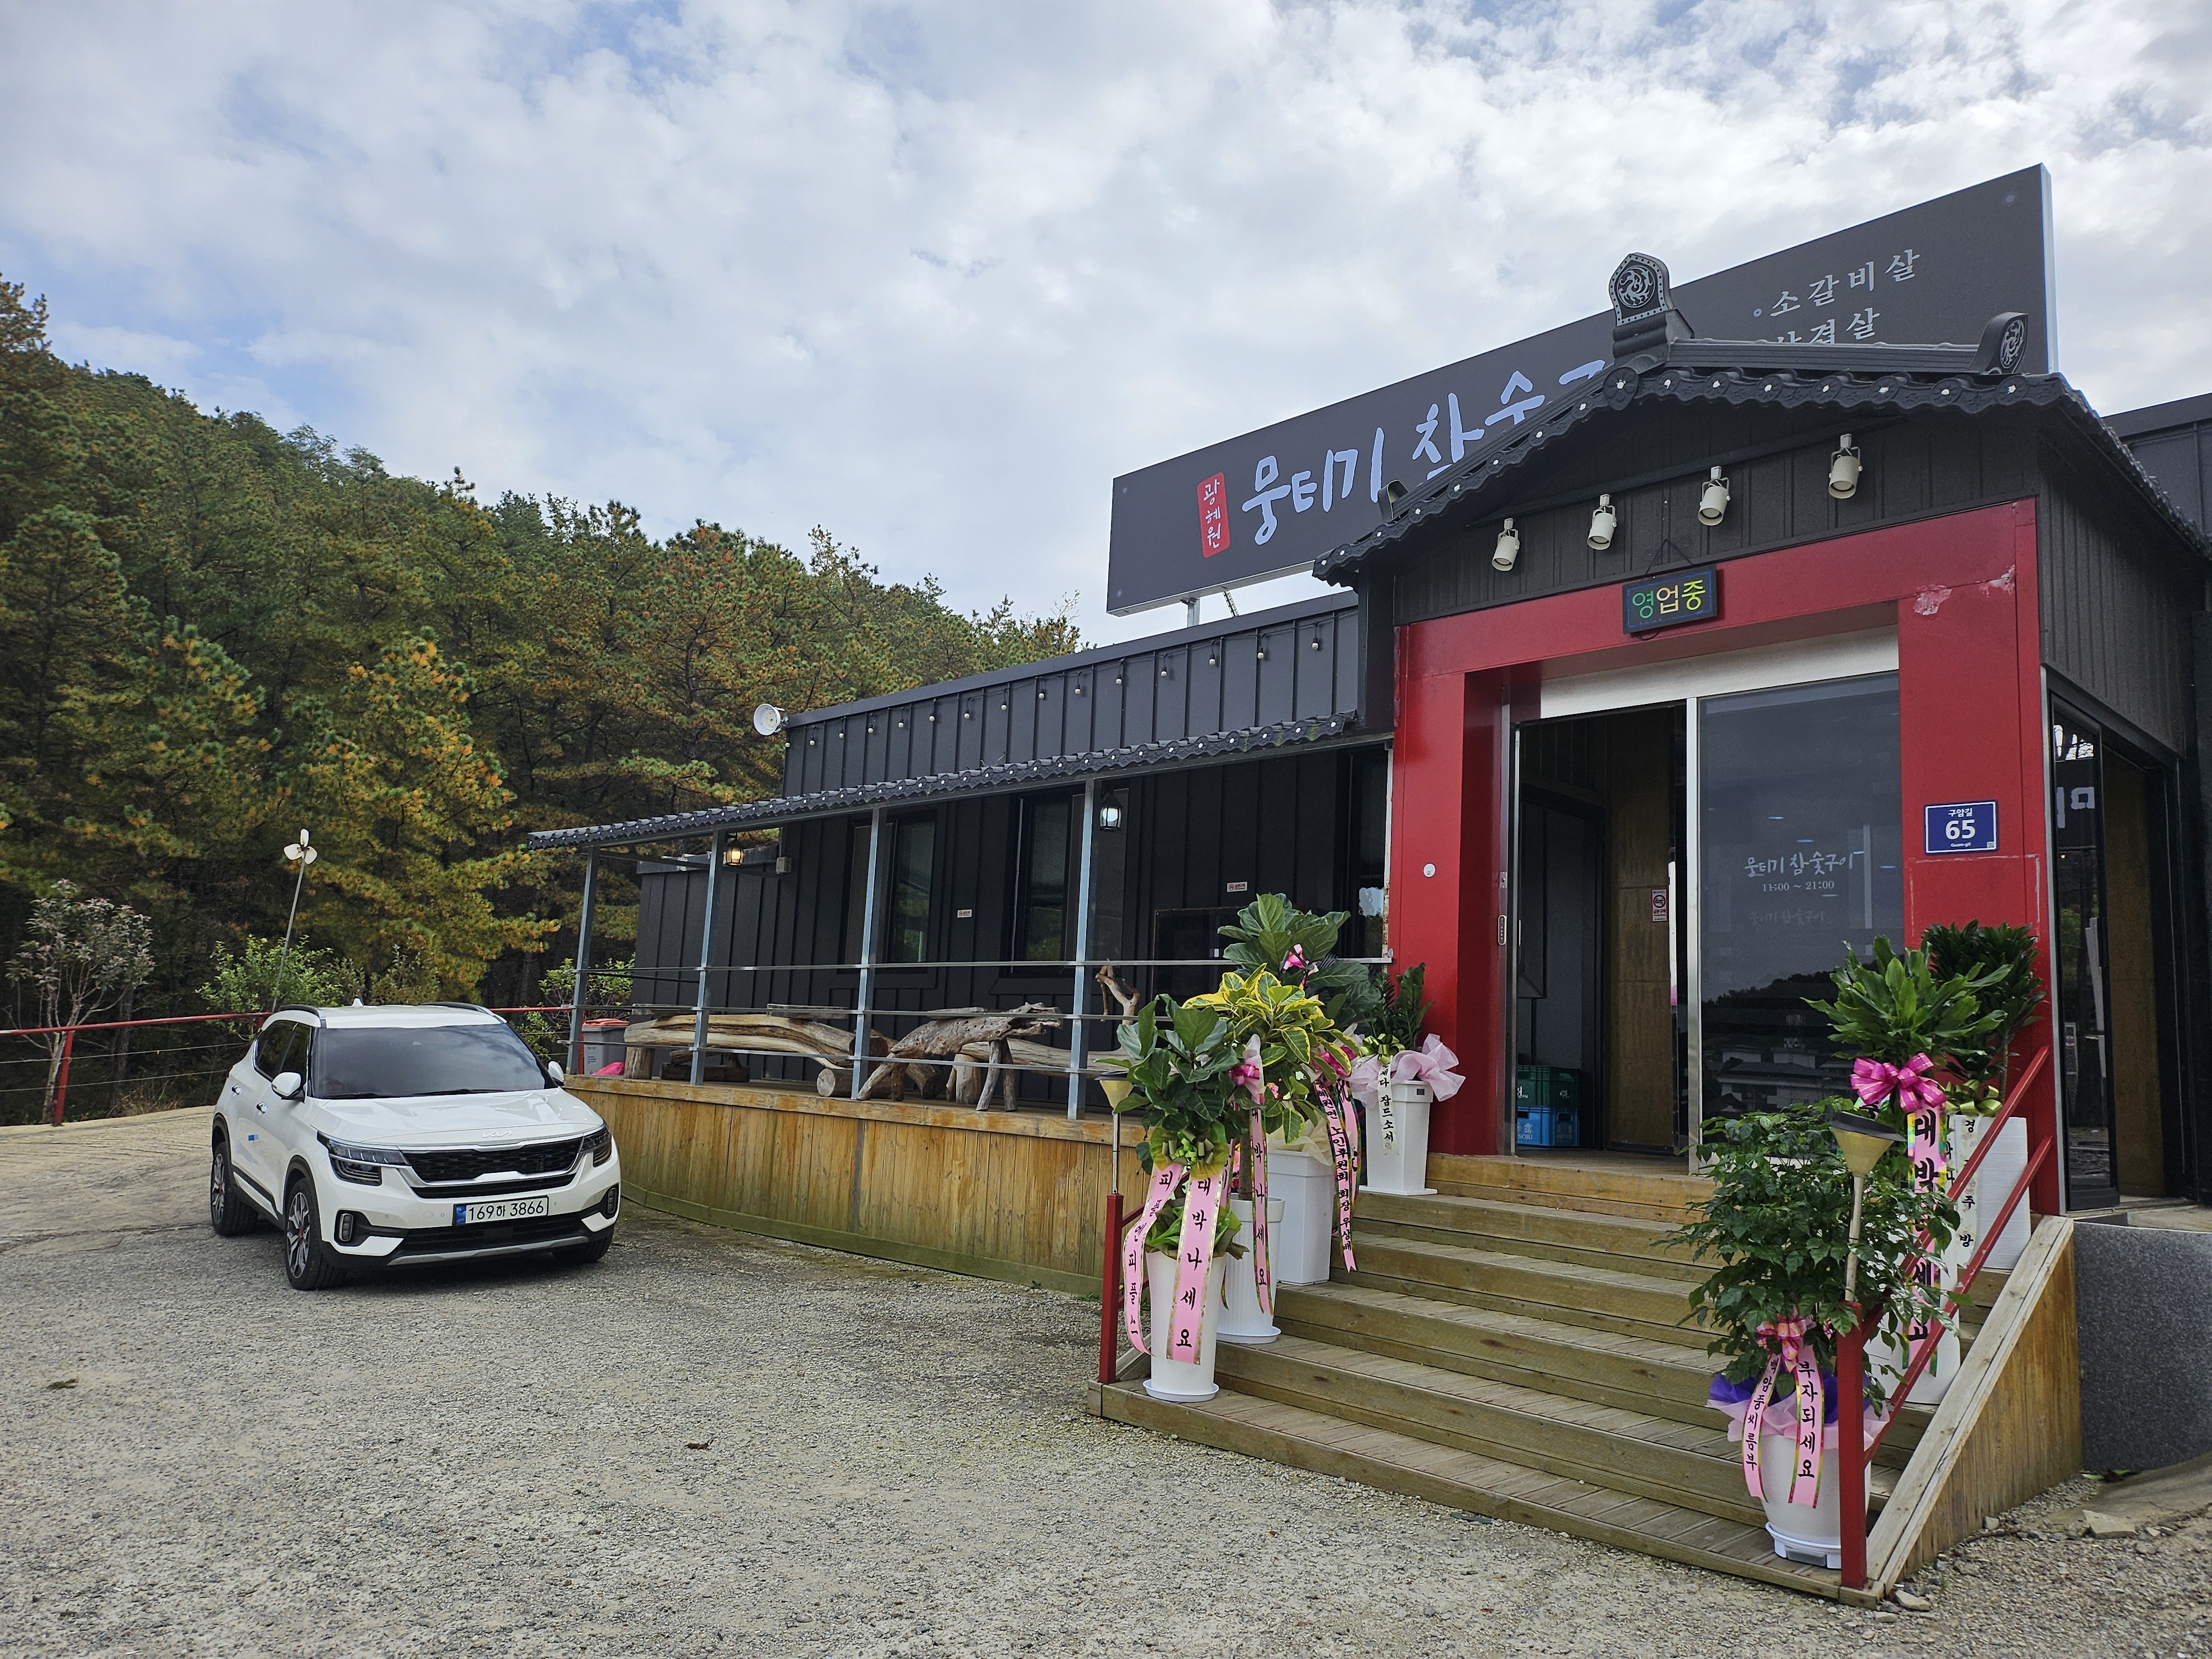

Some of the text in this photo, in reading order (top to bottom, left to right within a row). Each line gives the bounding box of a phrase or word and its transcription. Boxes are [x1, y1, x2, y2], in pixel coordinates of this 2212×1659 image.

[1770, 249, 1921, 317] 소갈비살
[1242, 427, 1384, 545] 뭉티기
[1203, 479, 1222, 549] 광혜원
[1632, 580, 1706, 619] 영업중
[1945, 819, 1976, 839] 65
[1948, 807, 1973, 817] 구암길
[1745, 851, 1853, 877] 뭉티기 참숯구이
[1762, 883, 1790, 892] 11:00
[1806, 880, 1835, 890] 21:00
[1380, 1094, 1394, 1142] 잠드소서
[1331, 1126, 1348, 1182] 노인후원회
[468, 1200, 544, 1221] 169하 3866
[1251, 1108, 1267, 1287] 대박나세요
[1338, 1188, 1350, 1212] 회장
[1339, 1217, 1352, 1251] 우상배
[1176, 1177, 1211, 1348] 대박나세요
[1797, 1361, 1818, 1478] 부자되세요
